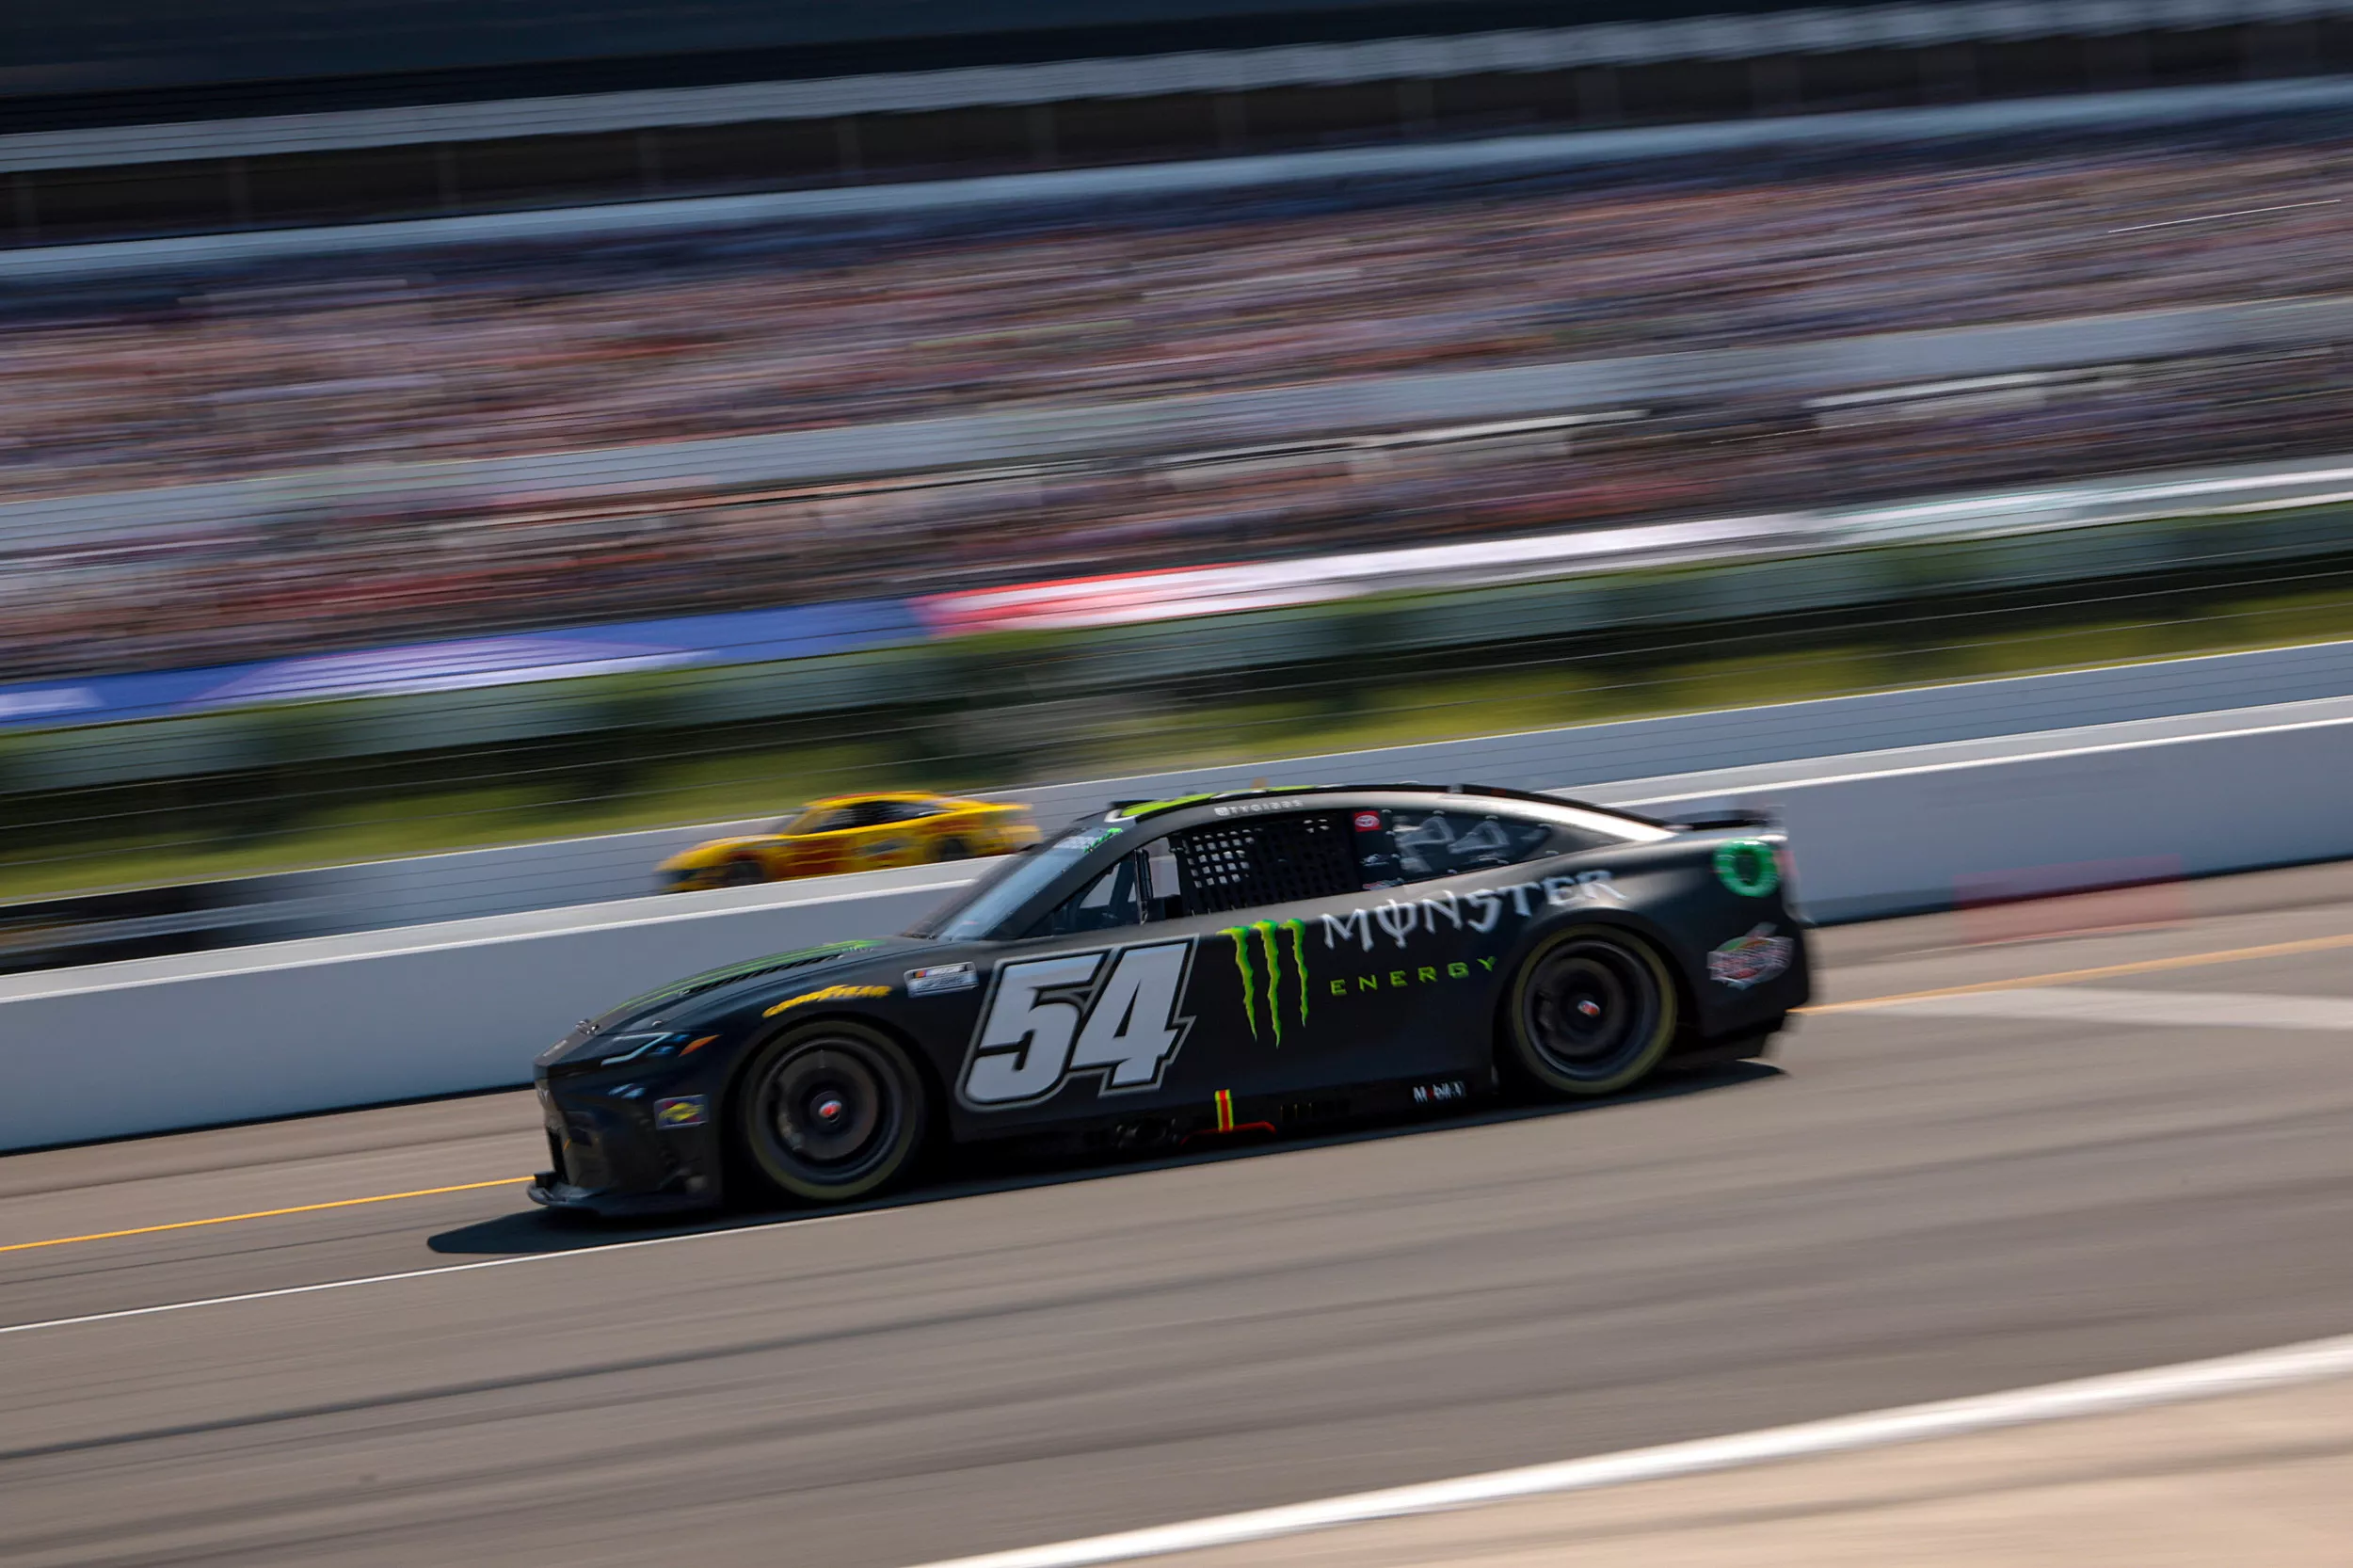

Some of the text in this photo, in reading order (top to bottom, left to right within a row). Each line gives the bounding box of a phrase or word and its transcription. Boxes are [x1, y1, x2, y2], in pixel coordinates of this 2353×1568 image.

[1321, 870, 1627, 952] MONSTER
[1330, 956, 1497, 996] ENERGY
[955, 934, 1200, 1112] 54
